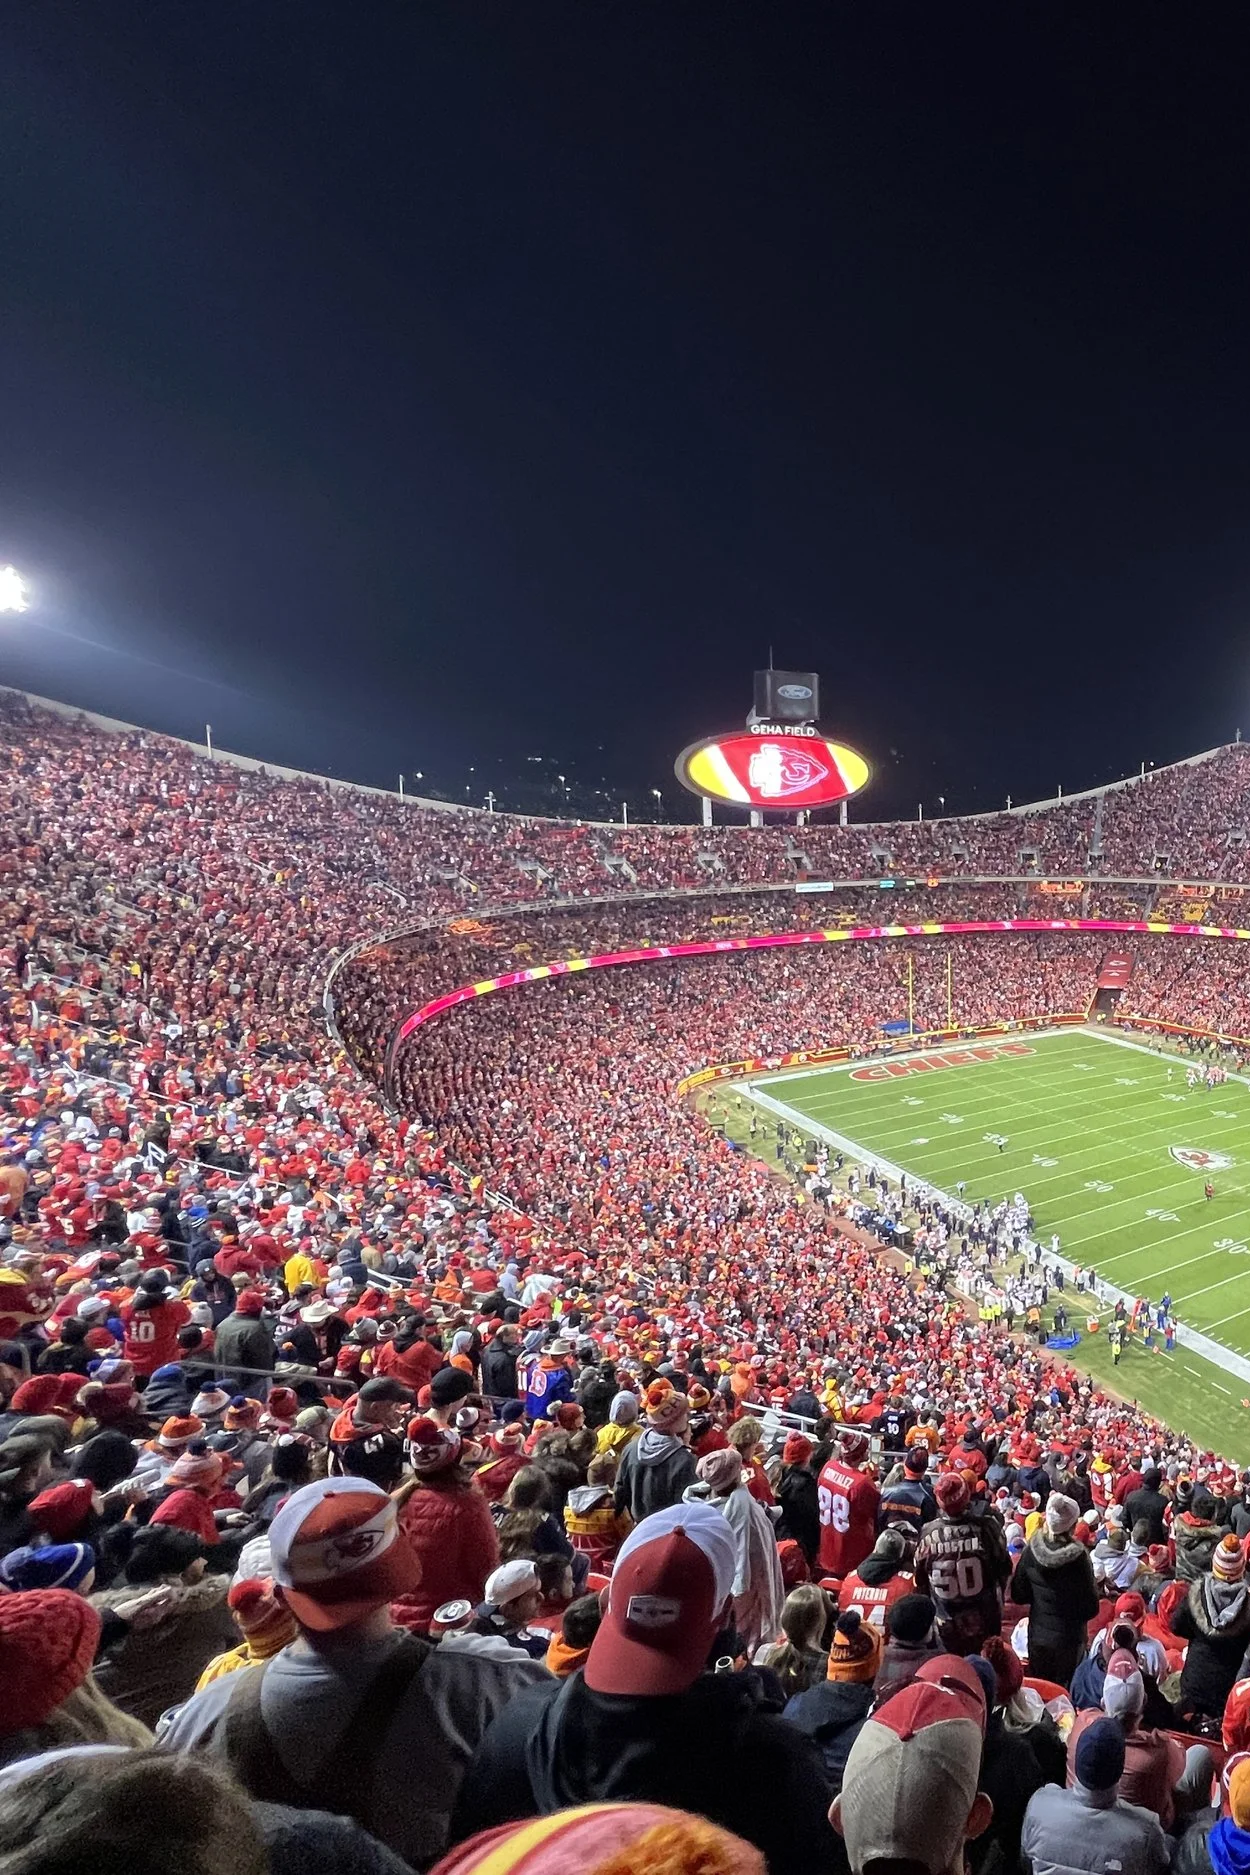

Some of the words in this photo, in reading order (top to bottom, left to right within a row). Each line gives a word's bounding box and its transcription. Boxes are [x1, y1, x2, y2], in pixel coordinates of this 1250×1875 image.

[750, 724, 784, 736] GEHA
[785, 726, 815, 737] FIELD
[848, 1042, 1037, 1082] CHIEFS
[1212, 1237, 1247, 1255] 30
[129, 1320, 156, 1343] 10
[887, 1422, 900, 1435] 10
[817, 1484, 850, 1534] 88
[930, 1536, 979, 1555] HOUSTON
[930, 1556, 983, 1600] 50
